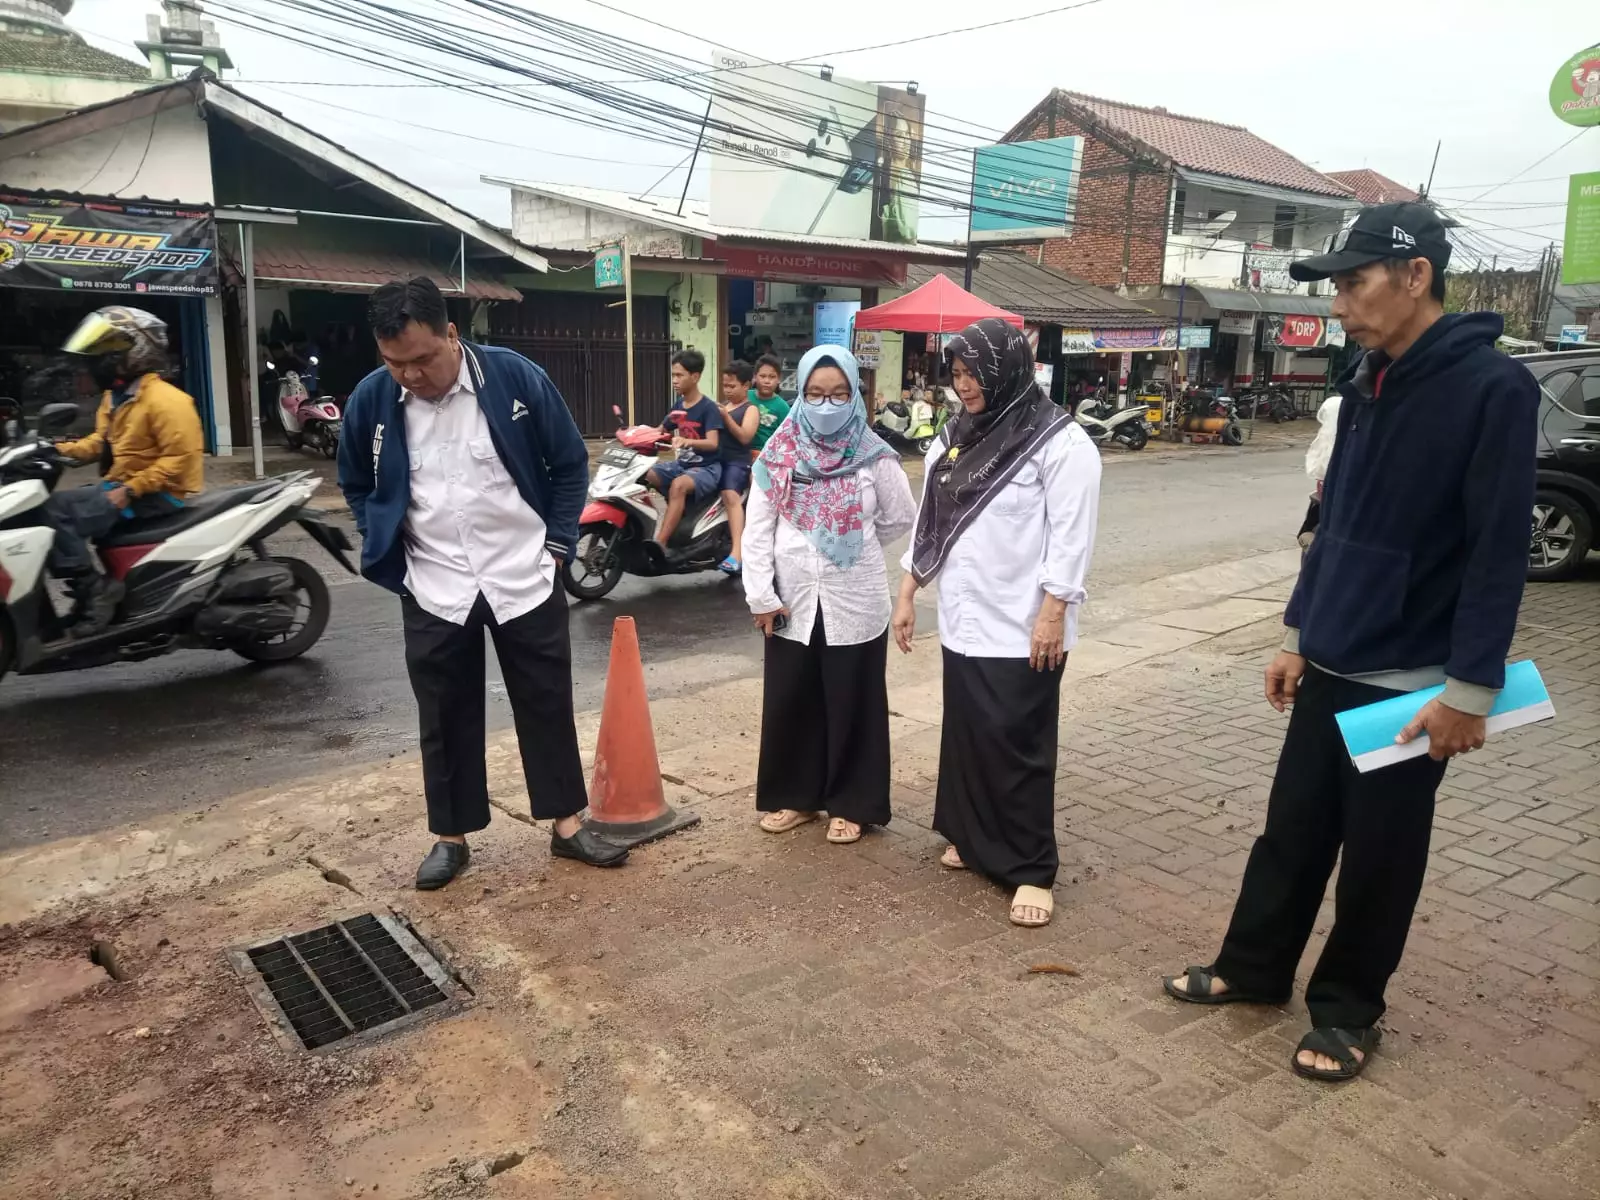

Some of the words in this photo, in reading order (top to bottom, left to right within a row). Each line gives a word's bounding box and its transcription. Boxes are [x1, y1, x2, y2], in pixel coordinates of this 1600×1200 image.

[753, 144, 779, 157] Reno8
[986, 176, 1057, 198] vivo
[0, 218, 164, 250] JAWA
[24, 243, 205, 269] SPEEDSHOP
[757, 253, 863, 273] HANDPHONE
[73, 280, 93, 288] 0878
[95, 281, 112, 289] 8730
[148, 283, 215, 293] jawaspeedshop85
